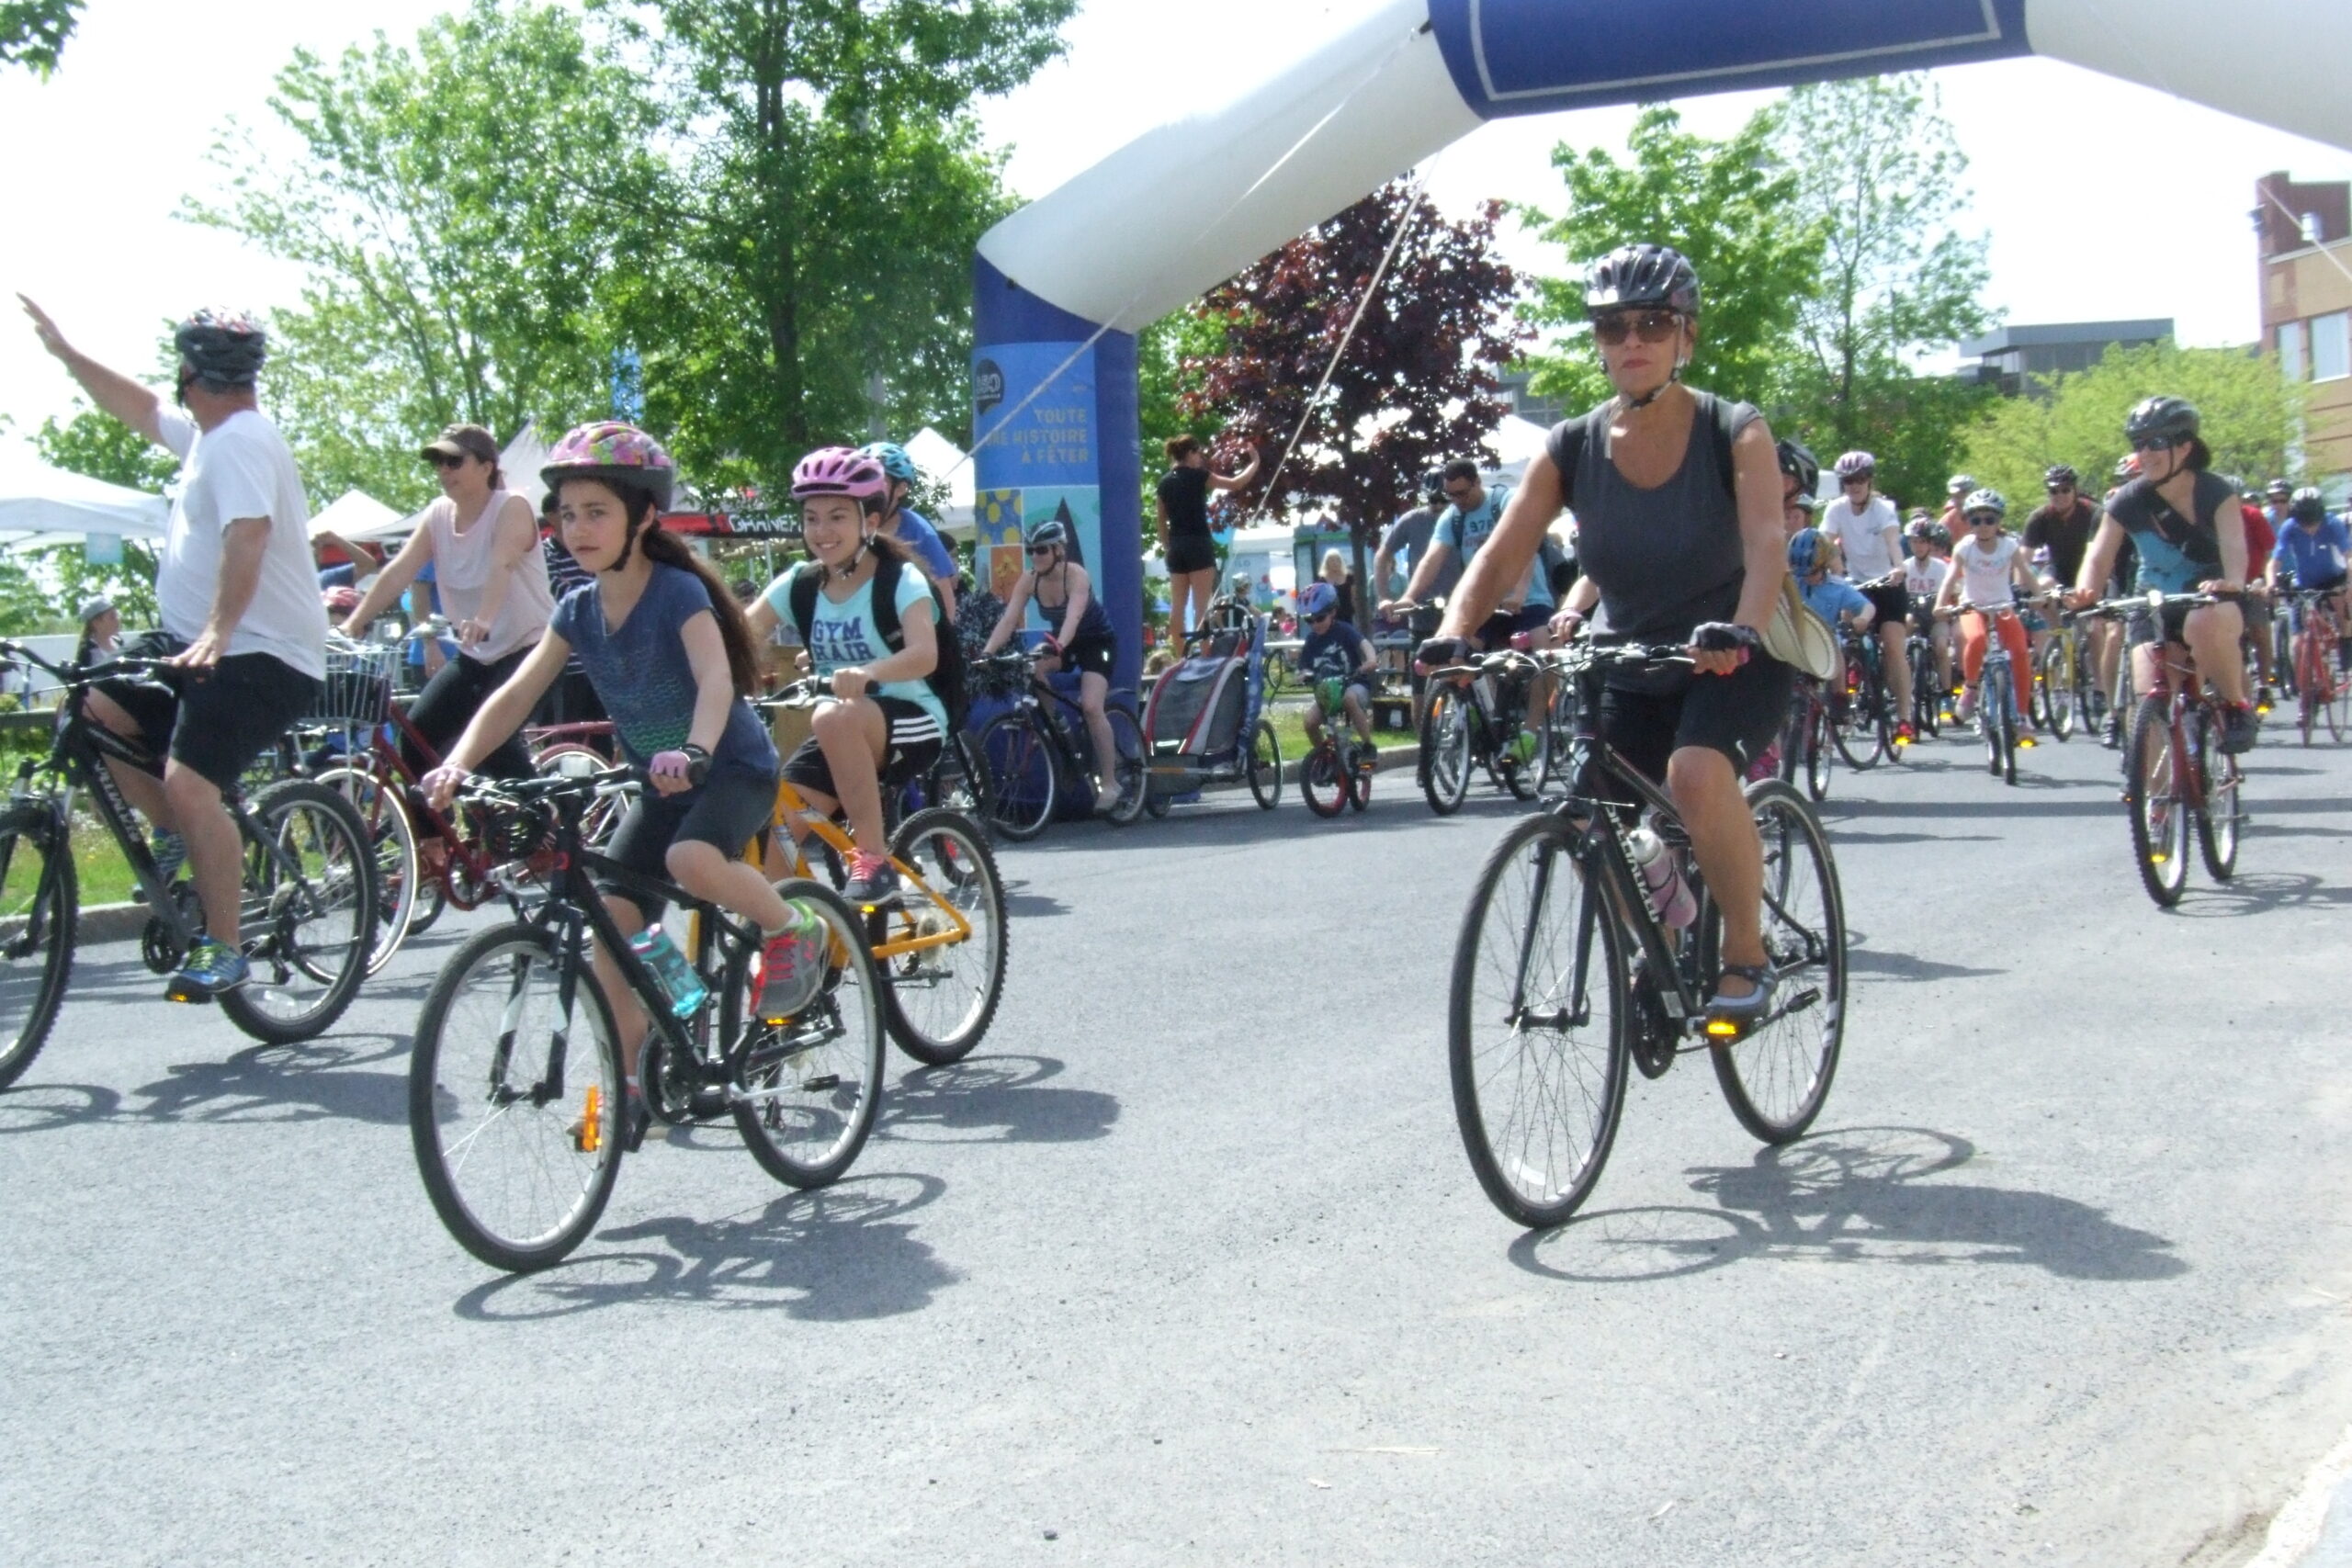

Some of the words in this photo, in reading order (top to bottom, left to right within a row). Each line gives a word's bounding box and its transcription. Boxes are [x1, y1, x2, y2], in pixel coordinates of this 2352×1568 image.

[1035, 409, 1088, 424] TOUTE
[1013, 428, 1088, 445] HISTOIRE
[1036, 444, 1089, 464] FÊTER
[1909, 578, 1936, 592] GAP
[813, 616, 865, 643] GYM
